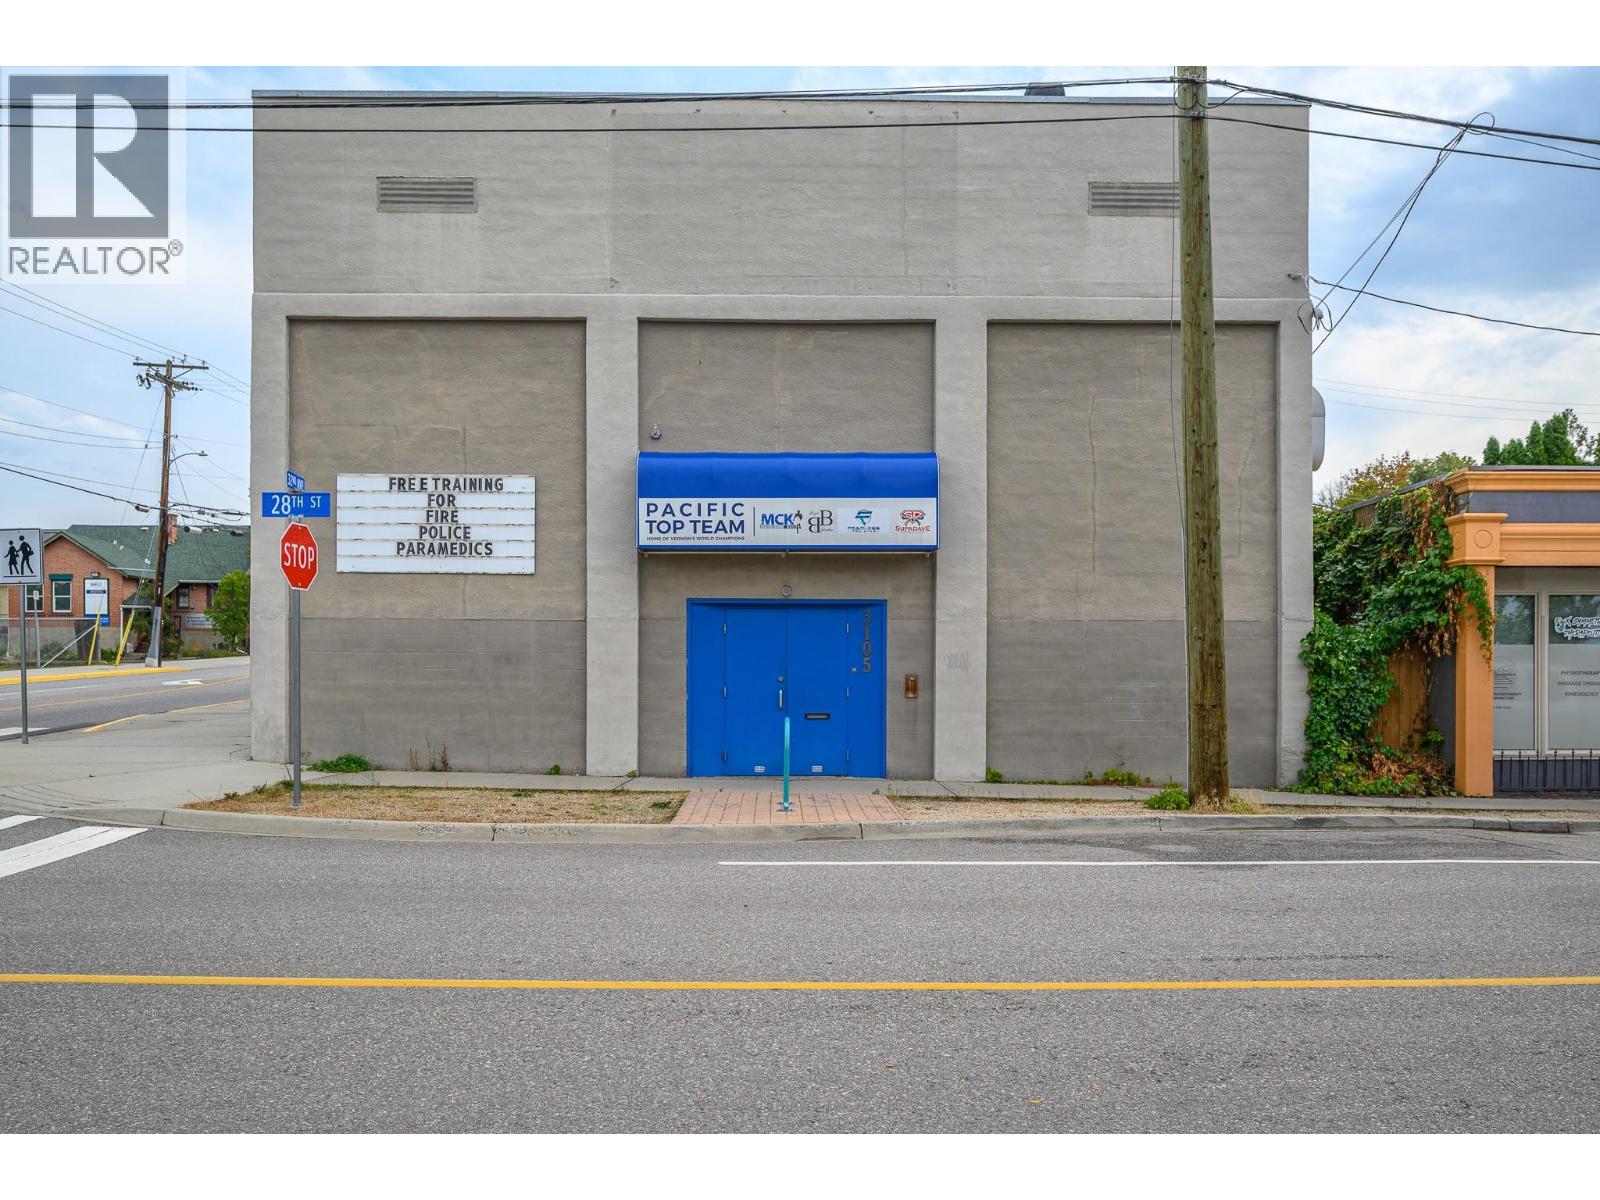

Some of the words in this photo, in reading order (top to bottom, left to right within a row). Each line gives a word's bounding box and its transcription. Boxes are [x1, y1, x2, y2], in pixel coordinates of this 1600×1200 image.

[389, 477, 428, 491] FREE
[432, 478, 504, 491] TRAINING
[271, 495, 304, 515] 28TH
[310, 496, 322, 508] ST
[427, 493, 456, 507] FOR
[426, 510, 459, 523] FIRE
[646, 502, 744, 517] PACIFIC
[761, 513, 794, 526] MCK
[419, 526, 471, 540] POLICE
[645, 520, 684, 534] TOP
[689, 520, 745, 534] TEAM
[284, 542, 315, 570] STOP
[396, 542, 493, 556] PARAMEDICS
